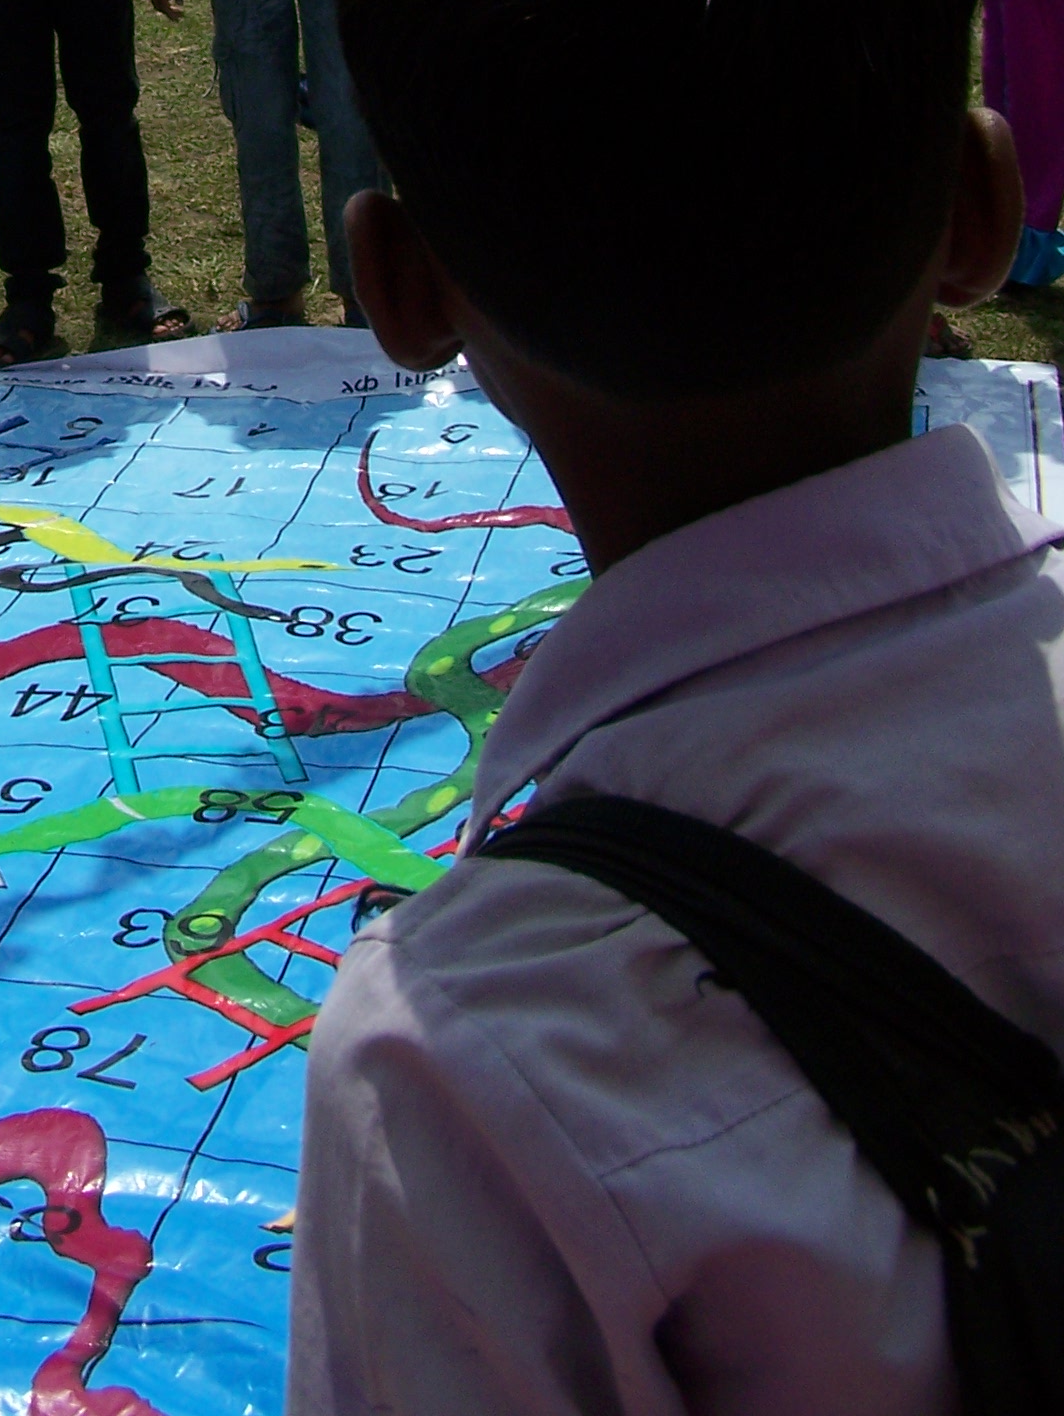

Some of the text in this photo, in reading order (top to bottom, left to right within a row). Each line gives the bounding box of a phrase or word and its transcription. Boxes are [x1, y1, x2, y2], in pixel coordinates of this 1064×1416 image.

[59, 417, 104, 441] 5
[441, 423, 480, 444] 3
[172, 476, 247, 498] 17
[133, 539, 225, 562] 24
[349, 543, 444, 575] 23
[59, 596, 161, 626] 37
[285, 605, 384, 646] 38
[10, 683, 114, 723] 44
[192, 788, 308, 826] 58
[112, 907, 236, 956] 63
[21, 1025, 148, 1089] 78
